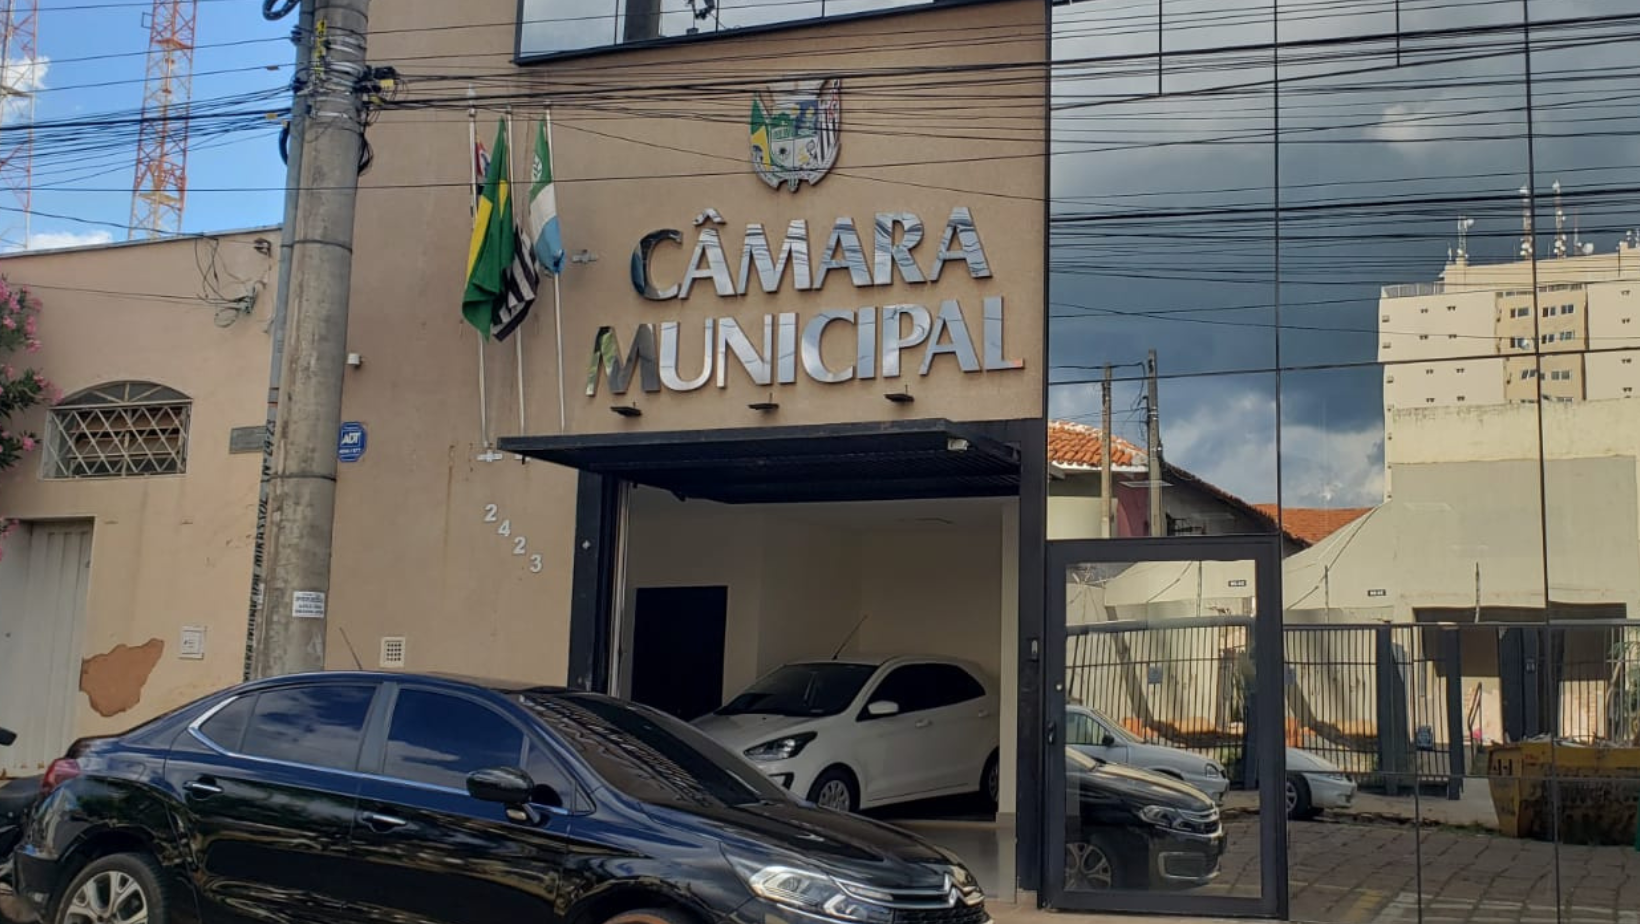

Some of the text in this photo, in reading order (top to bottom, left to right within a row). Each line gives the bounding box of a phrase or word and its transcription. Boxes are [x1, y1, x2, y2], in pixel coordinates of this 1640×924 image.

[631, 207, 992, 299] CÂMARA
[586, 296, 1024, 396] MUNICIPAL
[341, 432, 361, 444] ADT
